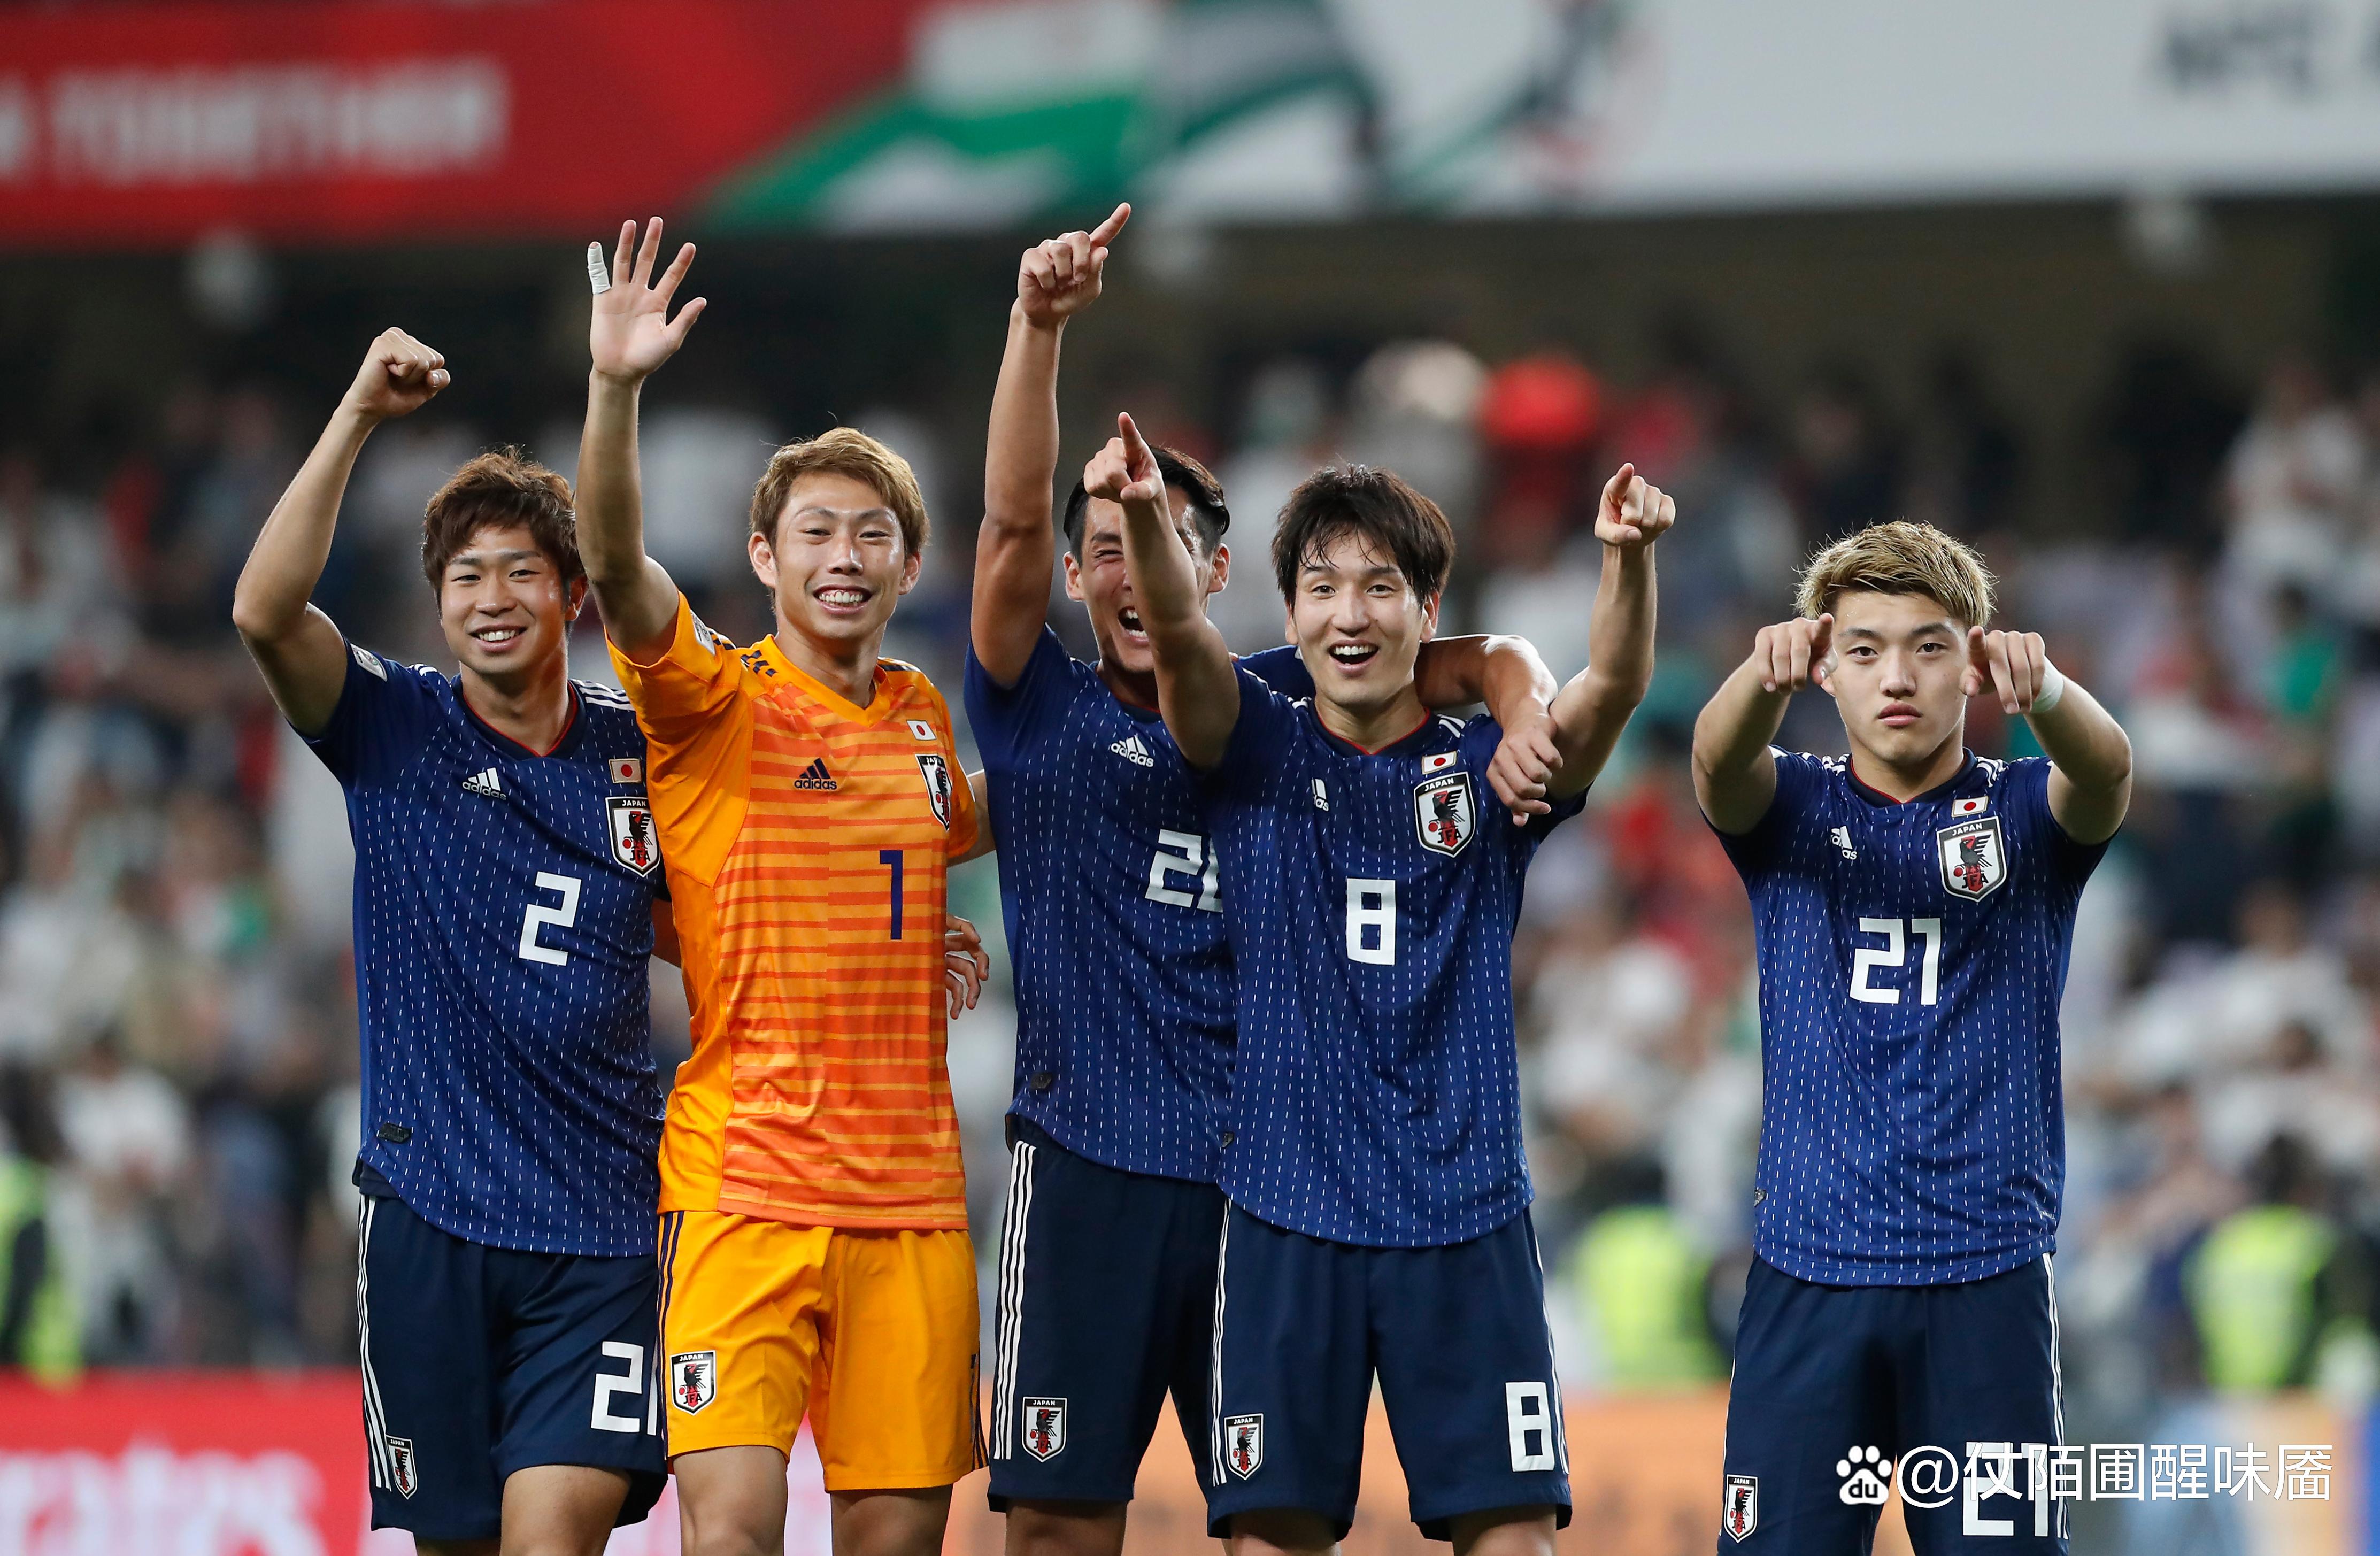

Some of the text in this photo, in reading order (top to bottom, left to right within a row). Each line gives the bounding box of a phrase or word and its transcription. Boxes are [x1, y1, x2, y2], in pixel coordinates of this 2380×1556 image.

[462, 781, 507, 800] adidas
[794, 777, 838, 790] adidas
[1424, 777, 1455, 792] JAPAN
[1437, 828, 1462, 844] JFA
[1952, 823, 1983, 836] JAPAN
[1961, 873, 1989, 889] JFA
[880, 850, 903, 940] 1
[519, 871, 582, 966] 2
[1346, 878, 1396, 965] 8
[1850, 917, 1942, 1005] 21
[679, 1353, 704, 1362] JAPAN
[683, 1393, 703, 1405] JFA
[1233, 1417, 1253, 1425] JAPAN
[1505, 1381, 1554, 1472] 8
[1963, 1442, 2048, 1537] 21
